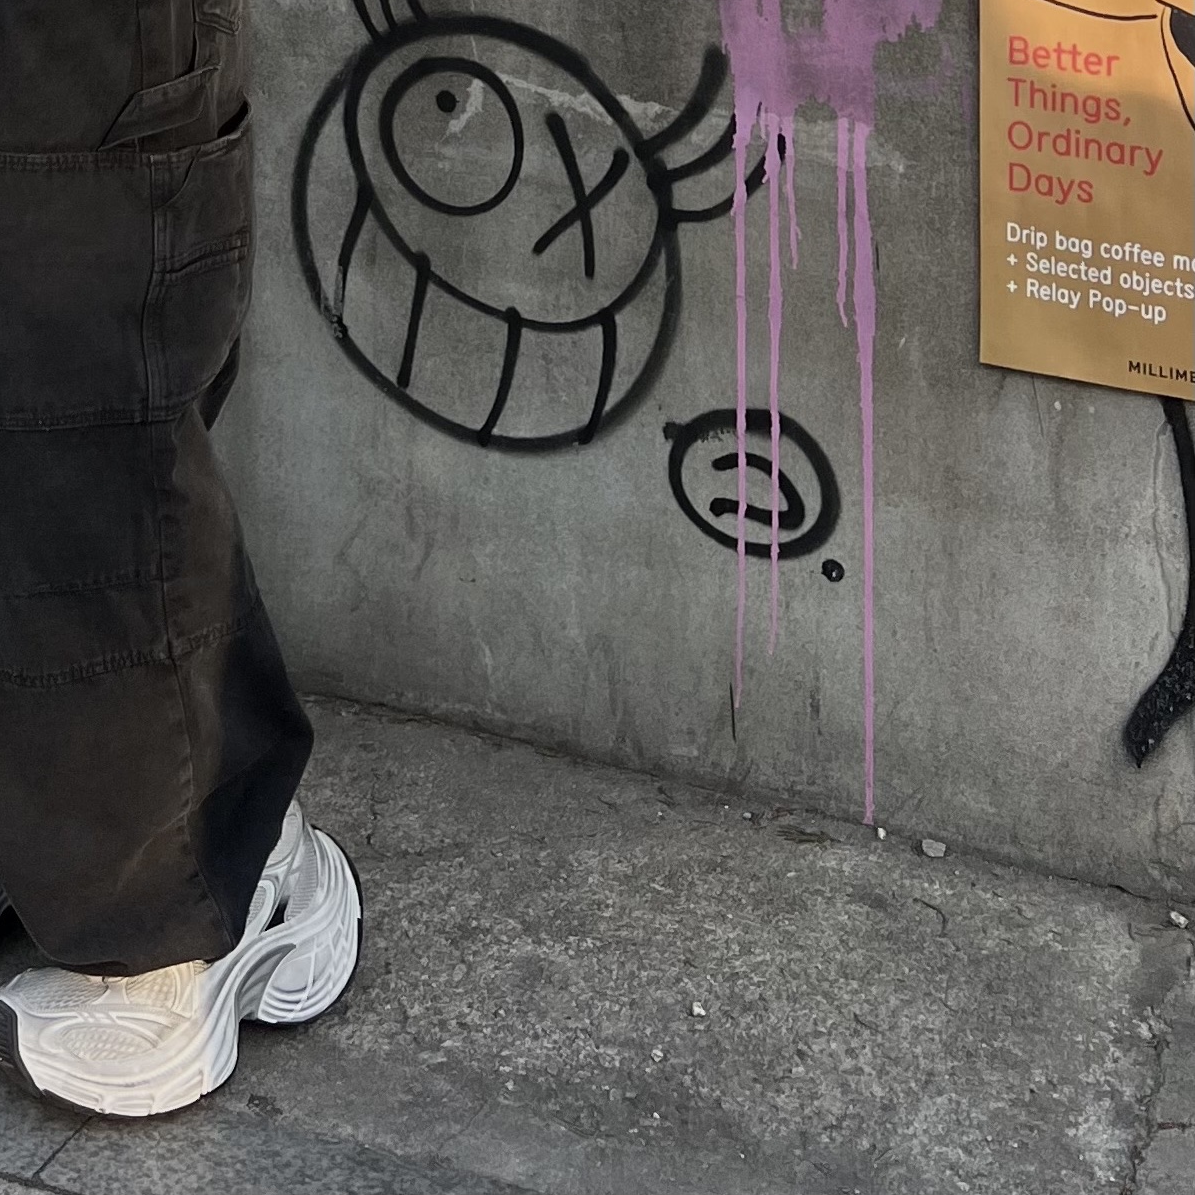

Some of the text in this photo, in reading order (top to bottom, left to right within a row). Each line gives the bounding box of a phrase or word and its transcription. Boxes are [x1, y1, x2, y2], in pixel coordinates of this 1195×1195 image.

[1008, 35, 1121, 77] Better
[1007, 76, 1131, 127] Things,
[1007, 120, 1164, 177] Ordinary
[1008, 161, 1094, 206] Days
[1006, 221, 1048, 251] Drip
[1055, 229, 1093, 259] bag
[1100, 241, 1166, 268] coffee
[1025, 251, 1113, 286] Selected
[1119, 269, 1195, 300] objects
[1026, 277, 1082, 310] Relay
[1089, 288, 1168, 325] Pop-up
